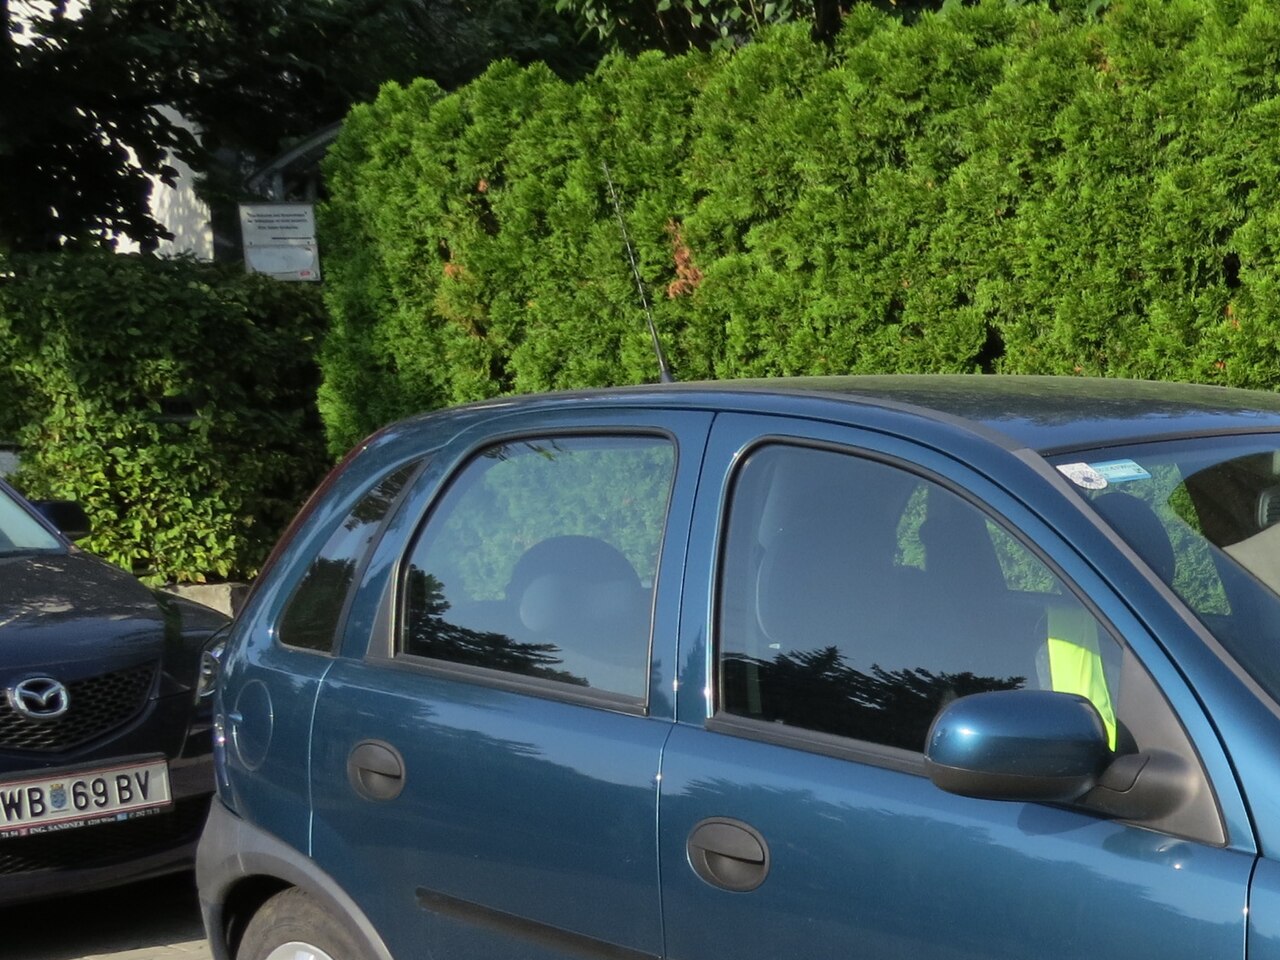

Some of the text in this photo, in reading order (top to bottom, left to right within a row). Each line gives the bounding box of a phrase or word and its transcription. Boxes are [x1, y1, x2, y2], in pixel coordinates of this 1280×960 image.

[0, 770, 150, 821] WB 69 BV
